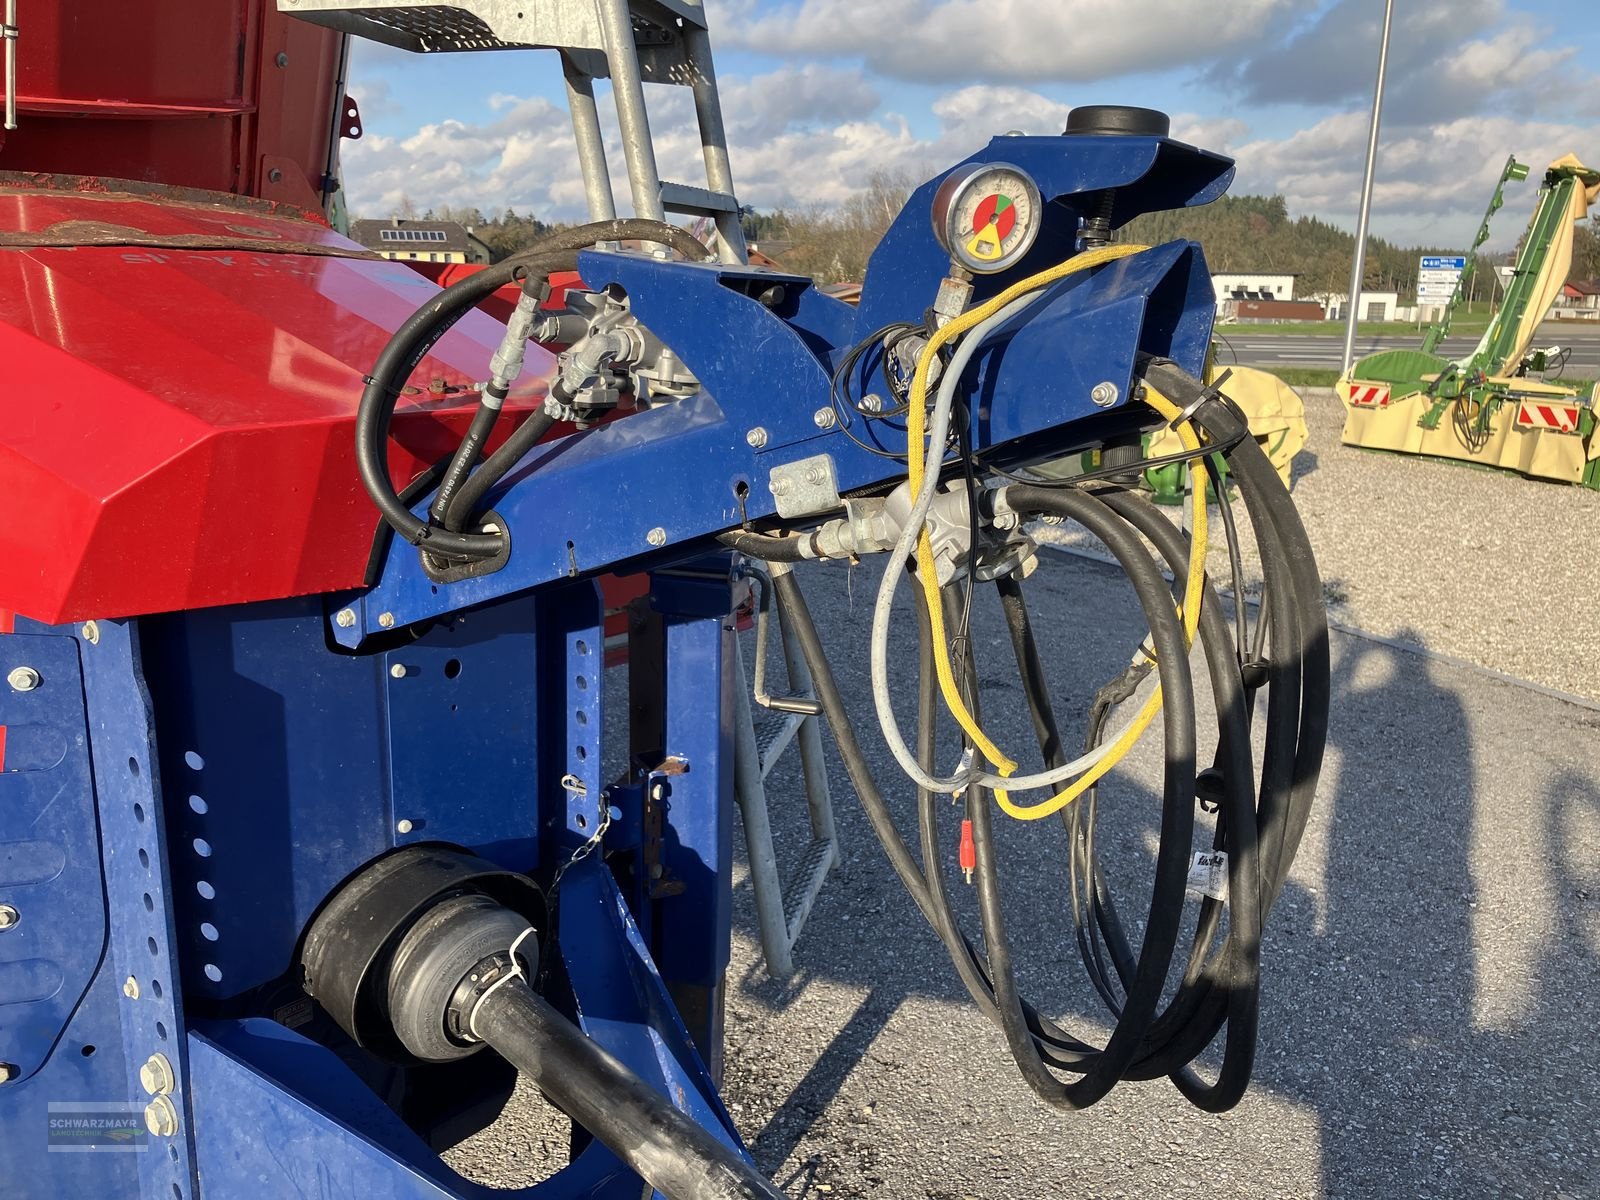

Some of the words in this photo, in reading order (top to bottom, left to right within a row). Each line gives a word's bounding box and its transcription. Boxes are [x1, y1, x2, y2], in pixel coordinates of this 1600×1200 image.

[437, 498, 447, 511] DIN
[442, 479, 455, 498] 74310
[458, 458, 466, 467] 23
[463, 441, 474, 457] 2017
